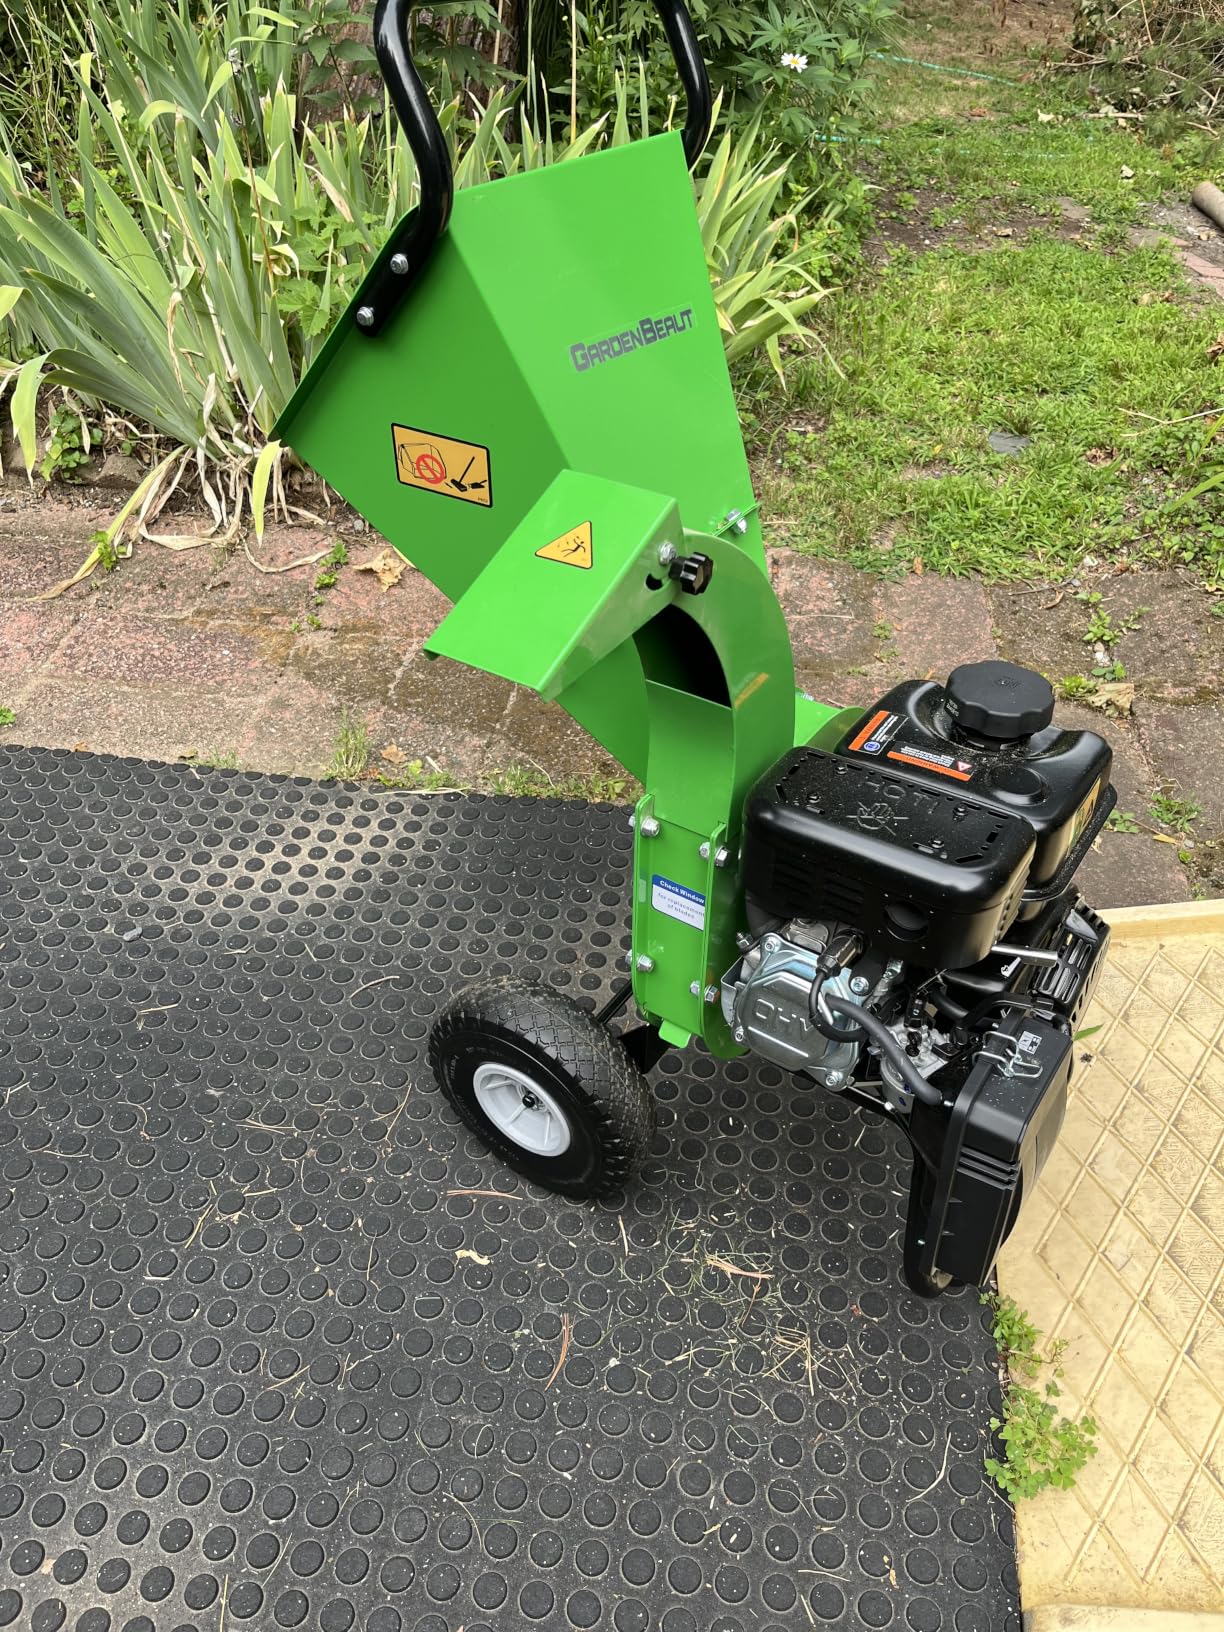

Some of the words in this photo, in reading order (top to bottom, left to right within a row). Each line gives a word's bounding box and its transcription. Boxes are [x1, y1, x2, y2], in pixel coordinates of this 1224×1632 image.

[659, 880, 679, 892] Check
[679, 888, 705, 904] Window
[755, 998, 814, 1041] OHV
